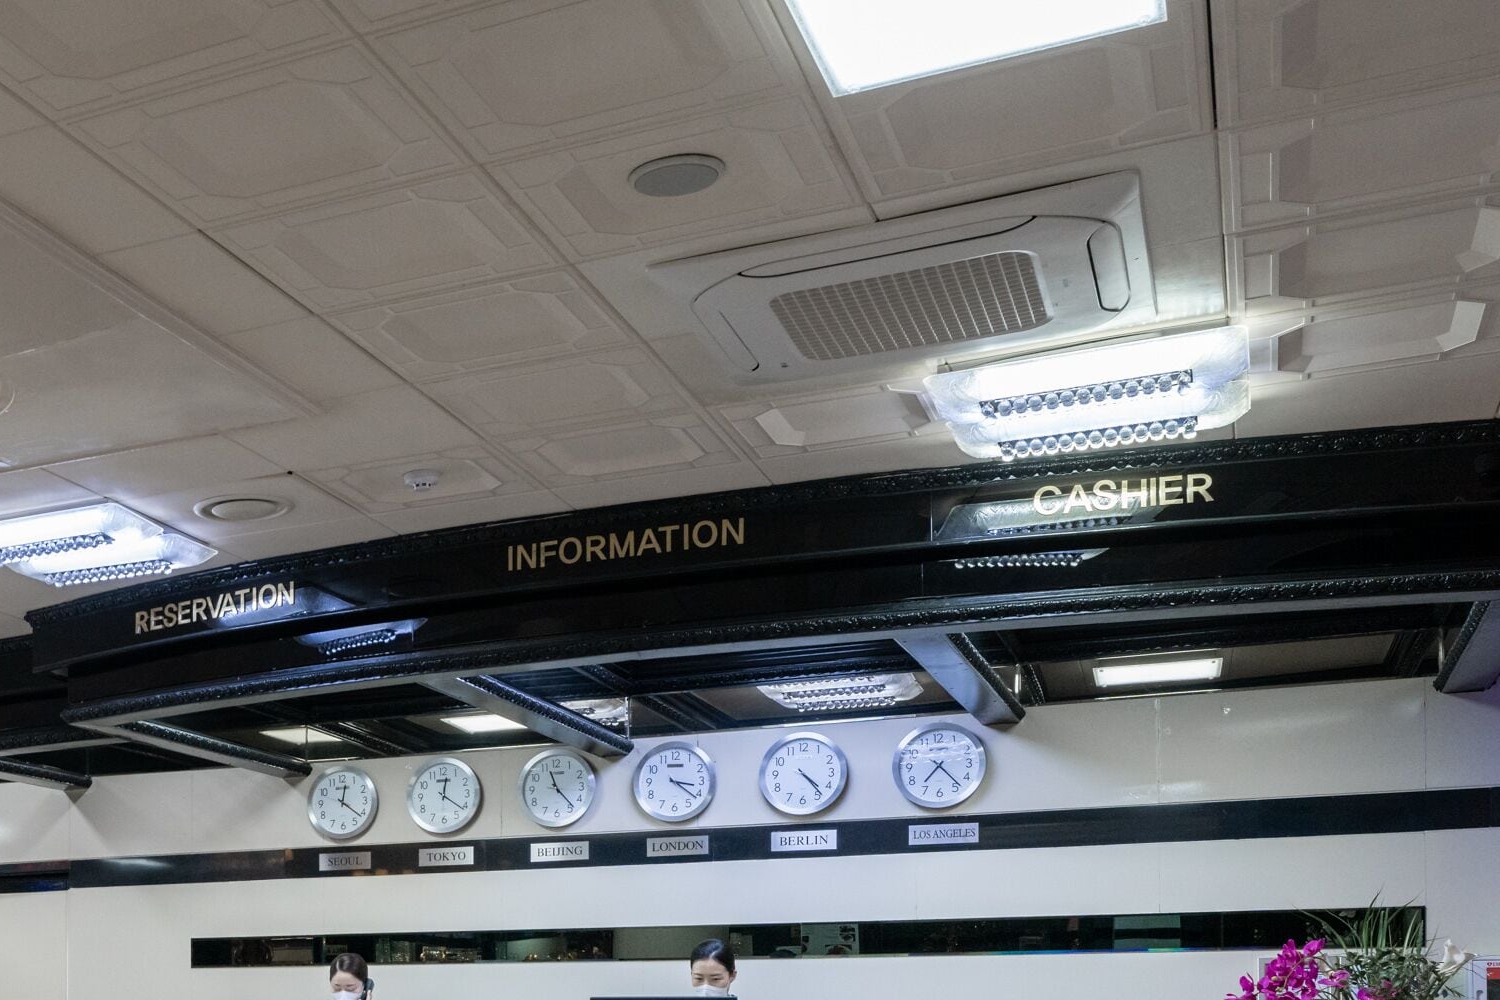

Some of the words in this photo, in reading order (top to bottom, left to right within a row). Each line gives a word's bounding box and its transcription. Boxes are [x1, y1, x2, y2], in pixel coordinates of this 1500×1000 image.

[1034, 473, 1214, 515] CASHIER
[507, 517, 745, 571] INFORMATION
[135, 581, 294, 634] RESERVATION
[920, 738, 929, 748] 11
[933, 733, 944, 743] 12
[787, 746, 795, 756] 11
[799, 742, 809, 752] 12
[964, 745, 971, 755] 2
[671, 751, 681, 761] 12
[909, 749, 919, 759] 10
[552, 759, 561, 769] 12
[660, 755, 667, 764] 11
[775, 757, 785, 767] 10
[826, 755, 833, 765] 2
[966, 758, 973, 768] 3
[439, 766, 448, 776] 12
[541, 763, 548, 772] 11
[649, 765, 658, 774] 10
[697, 764, 704, 773] 2
[828, 767, 835, 778] 3
[905, 763, 913, 773] 9
[338, 774, 346, 784] 12
[429, 771, 436, 780] 11
[531, 773, 540, 782] 10
[576, 770, 583, 779] 2
[772, 770, 779, 780] 9
[963, 772, 970, 781] 4
[329, 778, 336, 787] 11
[420, 781, 429, 790] 10
[462, 777, 468, 787] 2
[646, 778, 653, 787] 9
[698, 776, 705, 786] 3
[825, 781, 832, 790] 4
[908, 775, 916, 786] 8
[360, 785, 366, 793] 2
[529, 786, 535, 795] 9
[578, 782, 585, 791] 3
[774, 783, 781, 793] 8
[921, 785, 929, 795] 7
[952, 783, 959, 793] 5
[320, 788, 328, 797] 10
[418, 793, 424, 802] 9
[464, 789, 470, 798] 3
[648, 790, 654, 800] 8
[696, 789, 702, 798] 4
[786, 792, 793, 803] 7
[814, 791, 821, 801] 5
[936, 787, 944, 798] 6
[362, 797, 368, 805] 3
[531, 797, 538, 806] 8
[576, 794, 582, 803] 4
[685, 799, 692, 808] 5
[799, 795, 807, 805] 6
[318, 800, 324, 808] 9
[420, 804, 426, 814] 8
[567, 804, 573, 814] 5
[659, 800, 666, 809] 7
[671, 803, 678, 812] 6
[320, 810, 326, 819] 8
[360, 808, 366, 816] 4
[453, 811, 460, 820] 5
[542, 806, 548, 816] 7
[554, 809, 560, 818] 6
[352, 818, 358, 826] 5
[430, 813, 436, 821] 7
[441, 816, 448, 824] 6
[330, 819, 336, 828] 7
[341, 821, 347, 830] 6
[914, 830, 930, 839] LOS
[933, 828, 975, 838] ANGELES
[780, 835, 828, 846] BERLIN
[538, 846, 582, 857] BEIJING
[652, 841, 703, 852] LONDON
[328, 856, 362, 866] SEOUL
[427, 852, 465, 861] TOKYO
